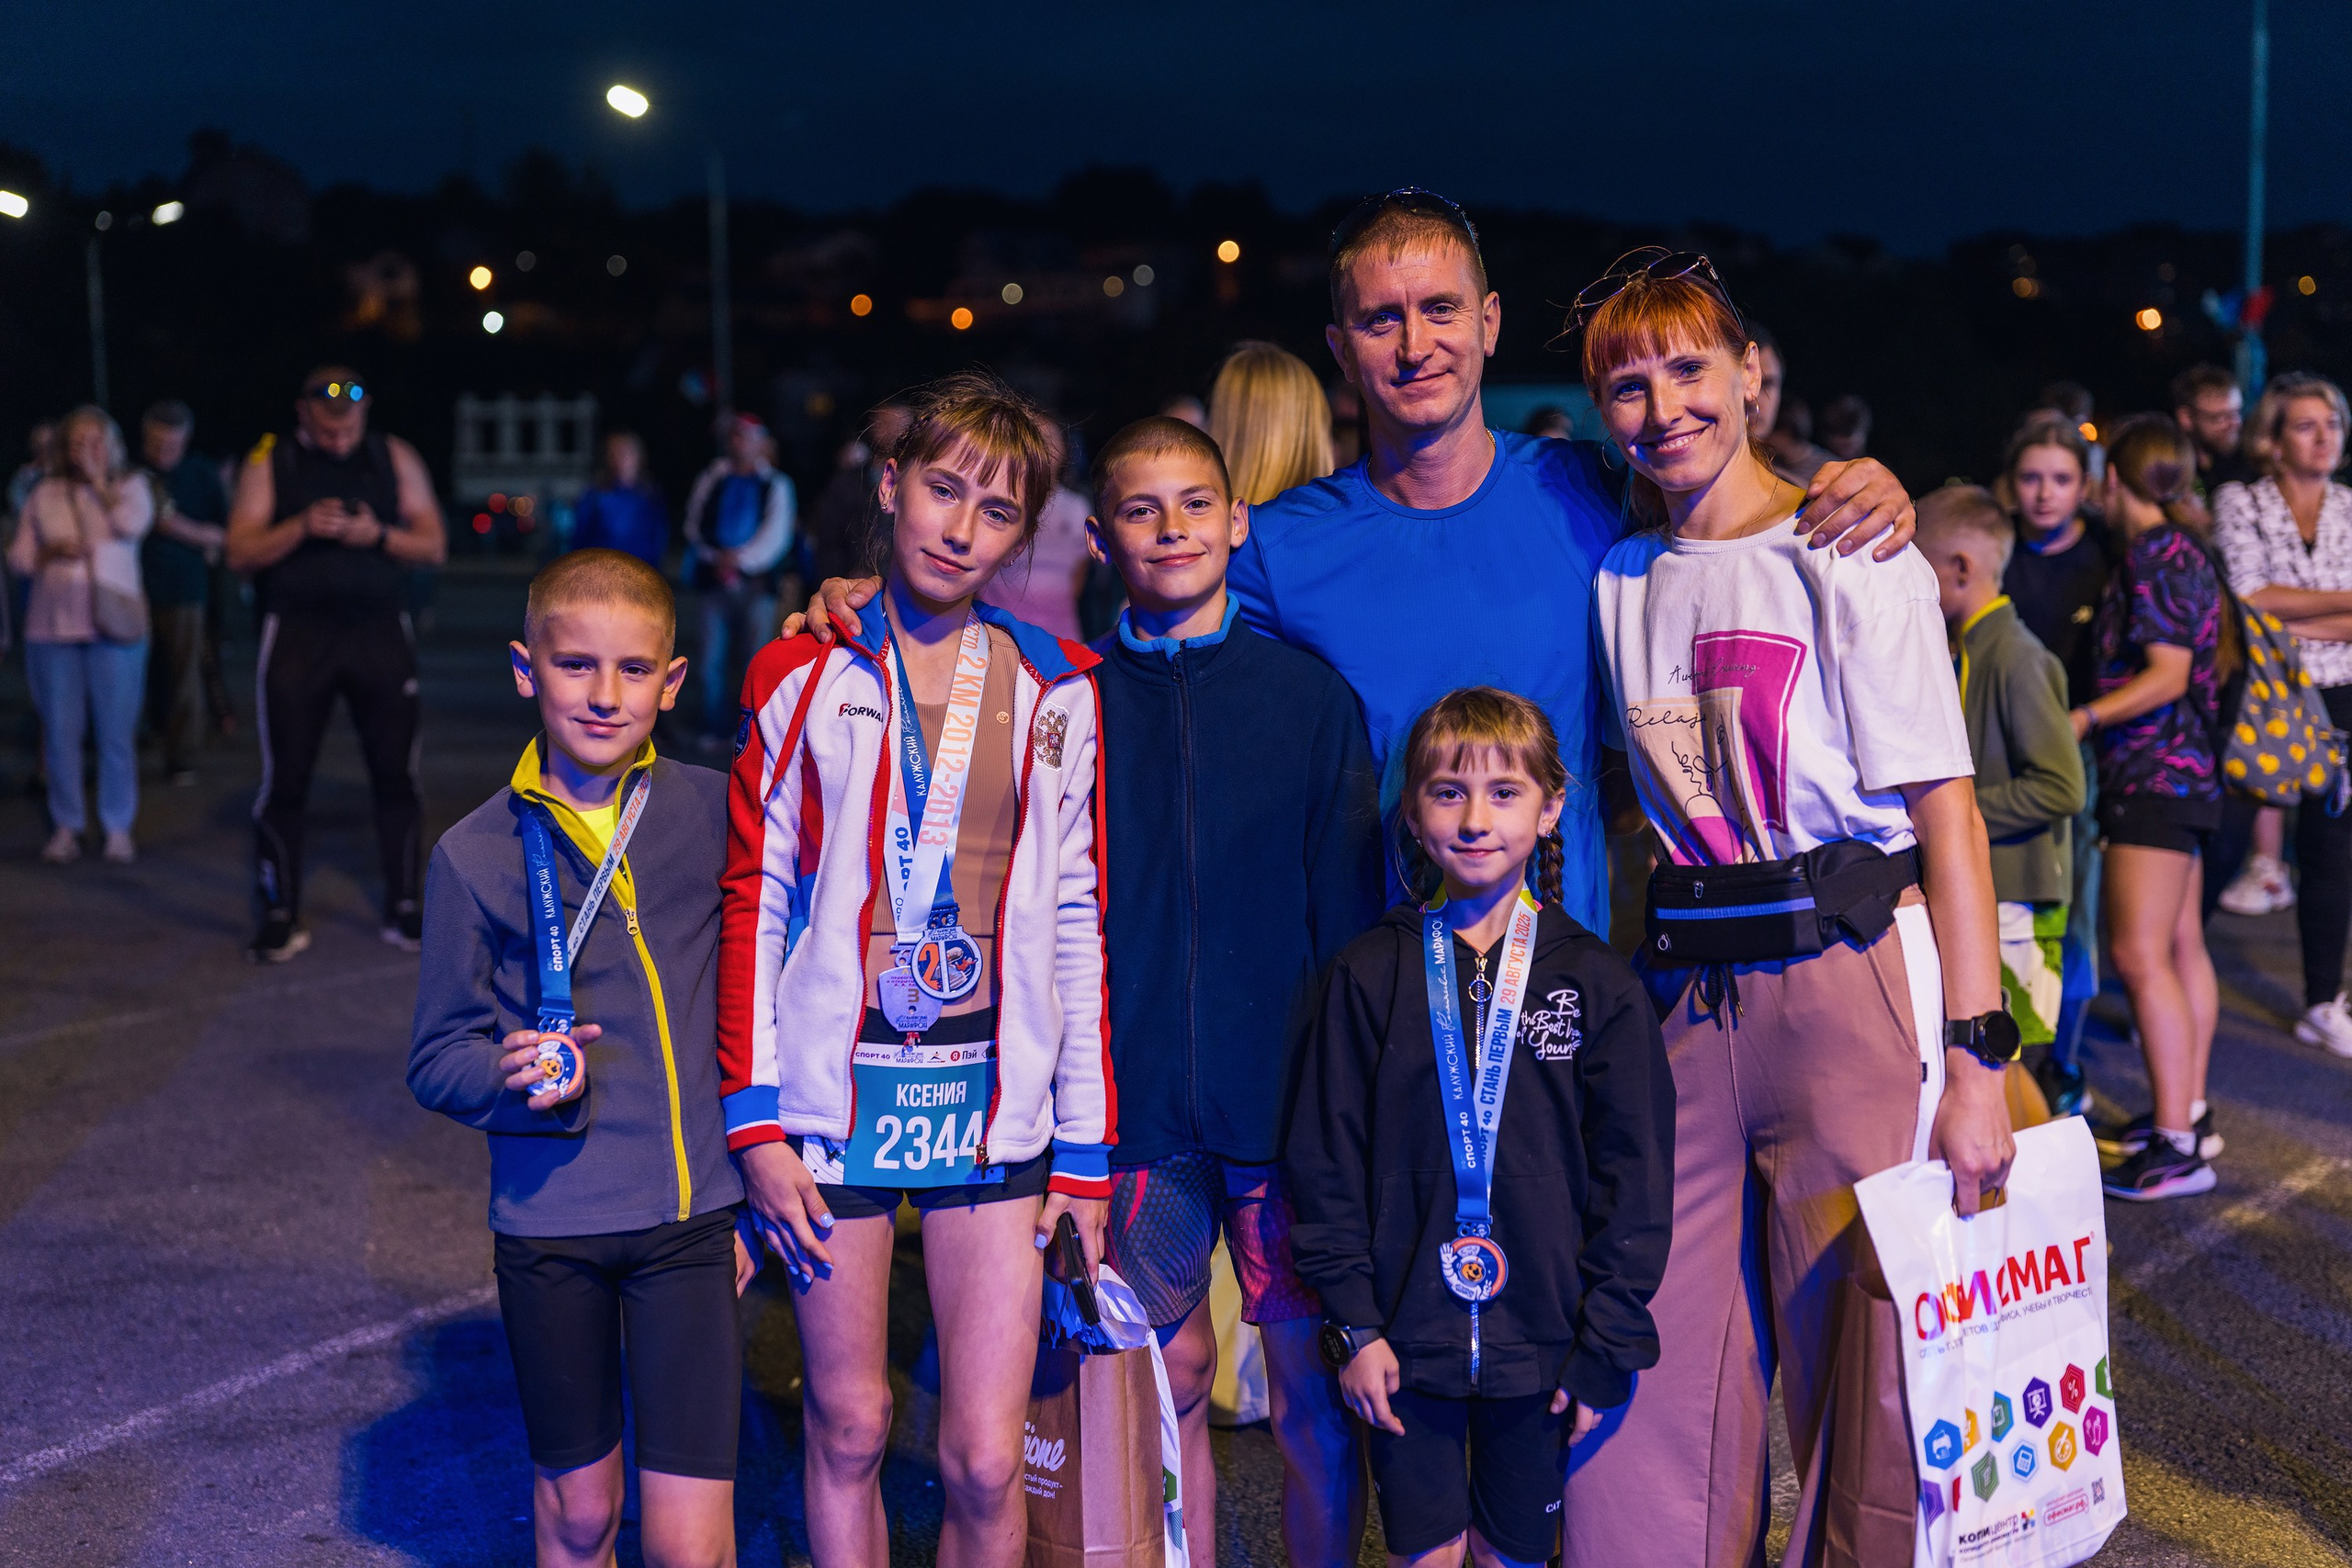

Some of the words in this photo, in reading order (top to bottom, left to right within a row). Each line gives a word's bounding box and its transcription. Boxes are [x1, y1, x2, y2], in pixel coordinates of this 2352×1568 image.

[950, 672, 984, 708] КМ
[838, 703, 884, 723] FORWA
[903, 736, 927, 796] КАЛУЖСКИЙ
[918, 716, 976, 846] 2012-2013
[895, 827, 910, 851] 40
[578, 900, 595, 934] СТАНЬ
[593, 852, 615, 901] ПЕРВЫМ
[612, 838, 622, 856] 29
[618, 796, 641, 842] АВГУСТА
[537, 868, 556, 919] КАЛУЖСКИЙ
[549, 926, 560, 936] 40
[1517, 911, 1532, 938] 2025
[551, 937, 564, 972] СПОРТ
[1505, 938, 1528, 987] АВГУСТА
[1500, 988, 1516, 1005] 29
[1546, 989, 1581, 1019] Be
[1487, 1009, 1512, 1064] ПЕРВЫМ
[1516, 1026, 1527, 1044] of
[1521, 1010, 1536, 1026] the
[1532, 1010, 1566, 1037] Best
[962, 1050, 978, 1060] Пэй
[1441, 1034, 1464, 1100] КАЛУЖСКИЙ
[896, 1081, 967, 1108] КСЕНИЯ
[1480, 1064, 1501, 1105] СТАНЬ
[1459, 1111, 1469, 1126] 40
[1482, 1111, 1493, 1125] 40
[874, 1111, 983, 1171] 2344
[1462, 1129, 1476, 1168] СПОРТ
